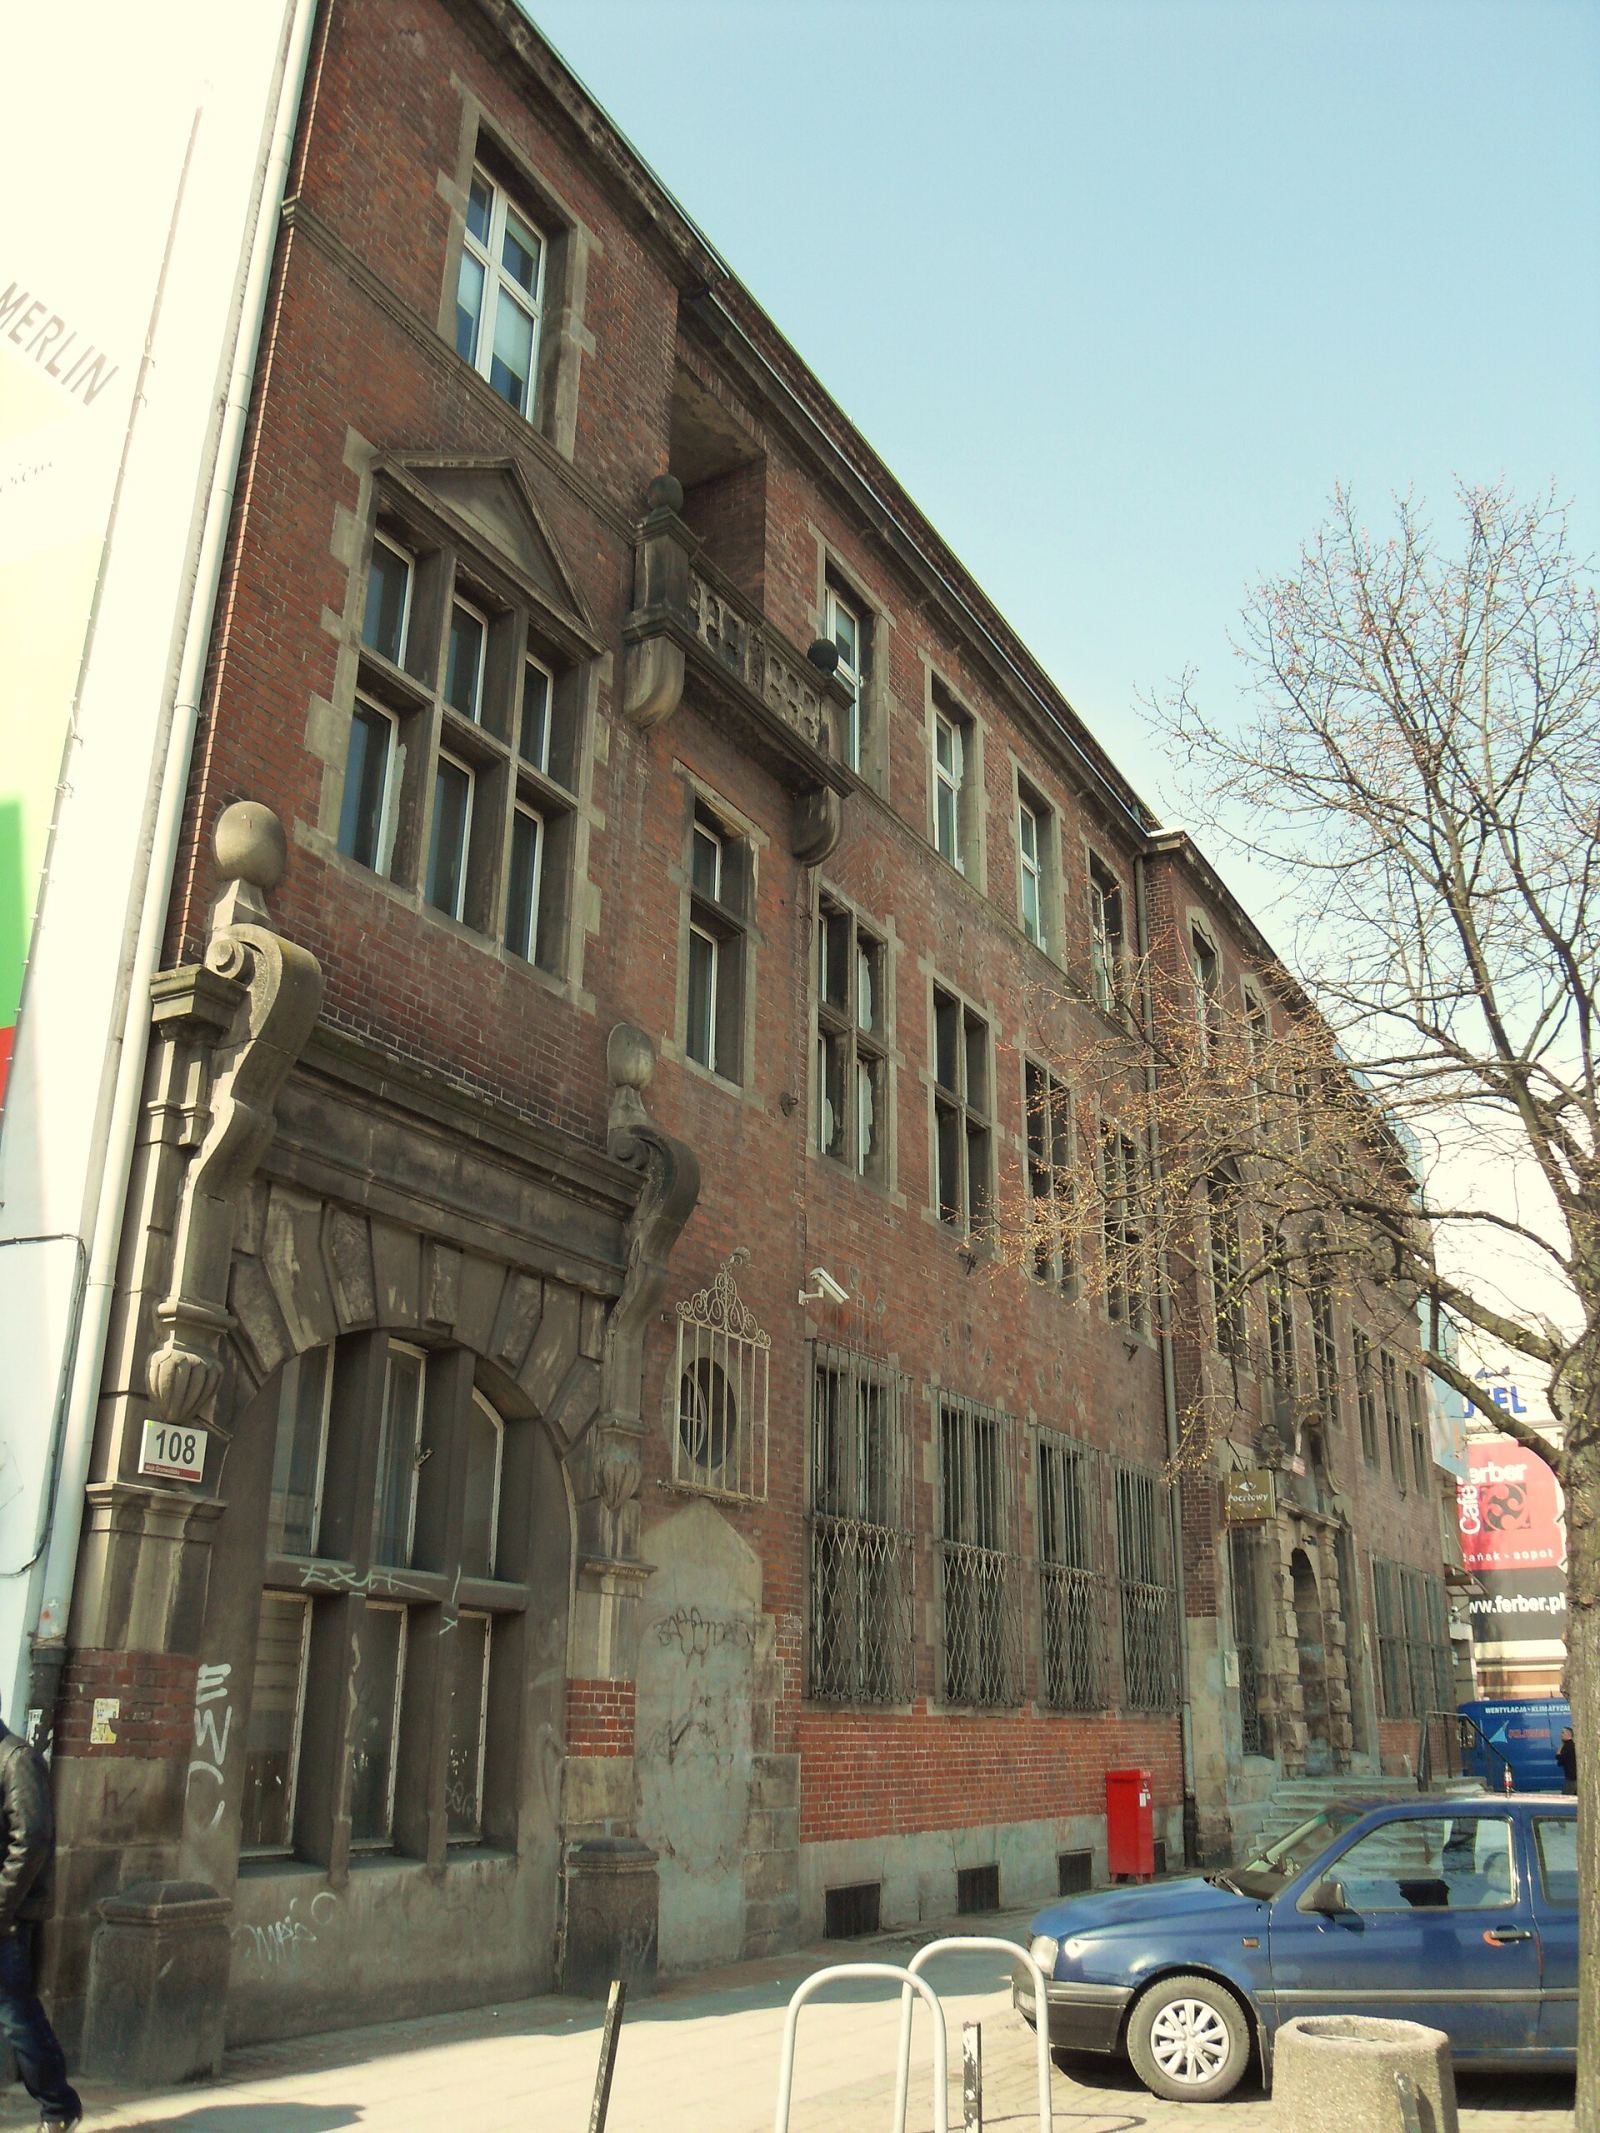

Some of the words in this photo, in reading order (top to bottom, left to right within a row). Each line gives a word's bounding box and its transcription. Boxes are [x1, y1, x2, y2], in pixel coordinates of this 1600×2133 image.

[156, 1429, 196, 1465] 108
[1468, 1462, 1528, 1484] erber
[1513, 1548, 1553, 1560] sopot
